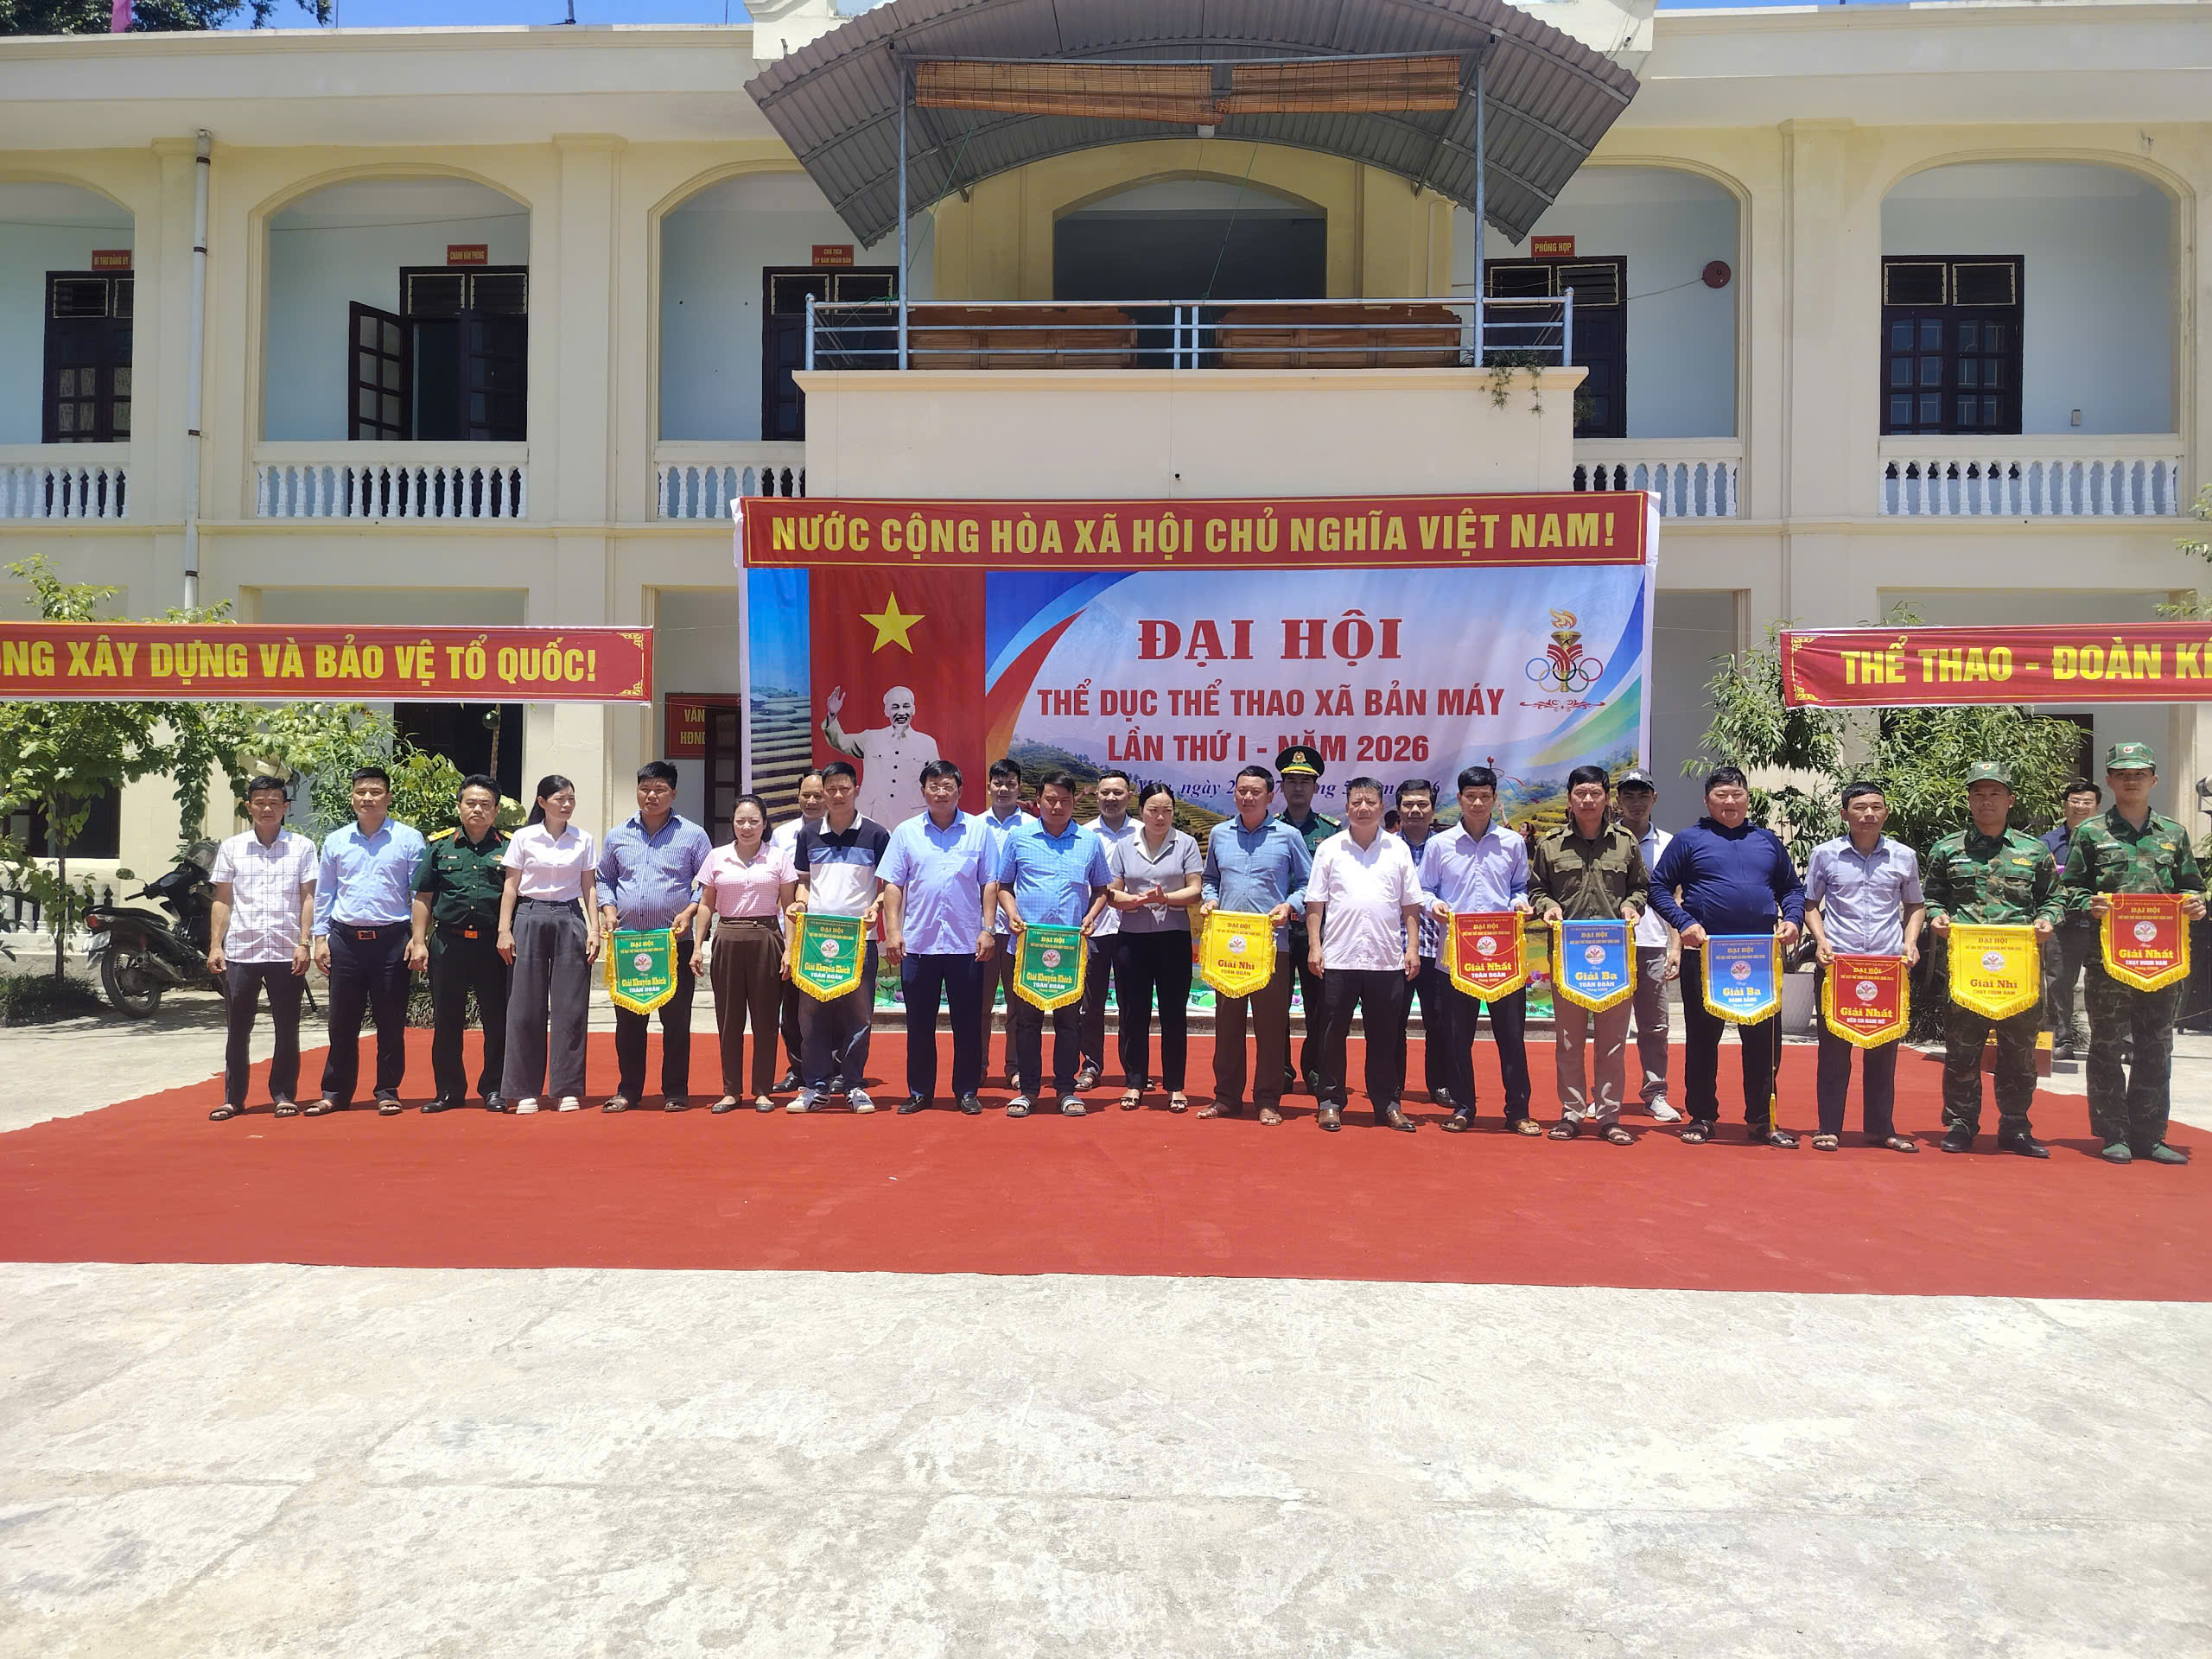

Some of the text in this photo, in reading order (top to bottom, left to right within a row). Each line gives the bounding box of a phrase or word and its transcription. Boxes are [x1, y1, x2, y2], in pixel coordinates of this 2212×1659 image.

[1535, 241, 1572, 254] PHÒNG HỌP
[772, 506, 1614, 560] NƯỚC CỘNG HÒA XÃ HỘI CHỦ NGHĨA VIỆT NAM!
[1138, 609, 1402, 667] ĐẠI HỘI
[0, 634, 595, 686] NG XÂY DỰNG VÀ BẢO VỆ TỔ QUỐC!
[1841, 636, 1906, 684] THỂ
[1917, 646, 2012, 683] THAO
[2052, 636, 2162, 680] ĐOÀN
[1038, 678, 1504, 721] THỂ DỤC THỂ THAO XÃ BẢN MÁY
[1109, 726, 1163, 761] LẦN
[1173, 730, 1231, 761] THỨ
[1238, 735, 1246, 761] I
[1357, 735, 1429, 761] 2026
[1180, 779, 1221, 798] ngày
[2119, 948, 2174, 959] Giải Nhất
[1464, 961, 1512, 971] Giải Nhất
[1575, 971, 1618, 981] Giải Ba
[1722, 987, 1762, 996] Giải Ba
[1840, 1007, 1893, 1018] Giải Nhất
